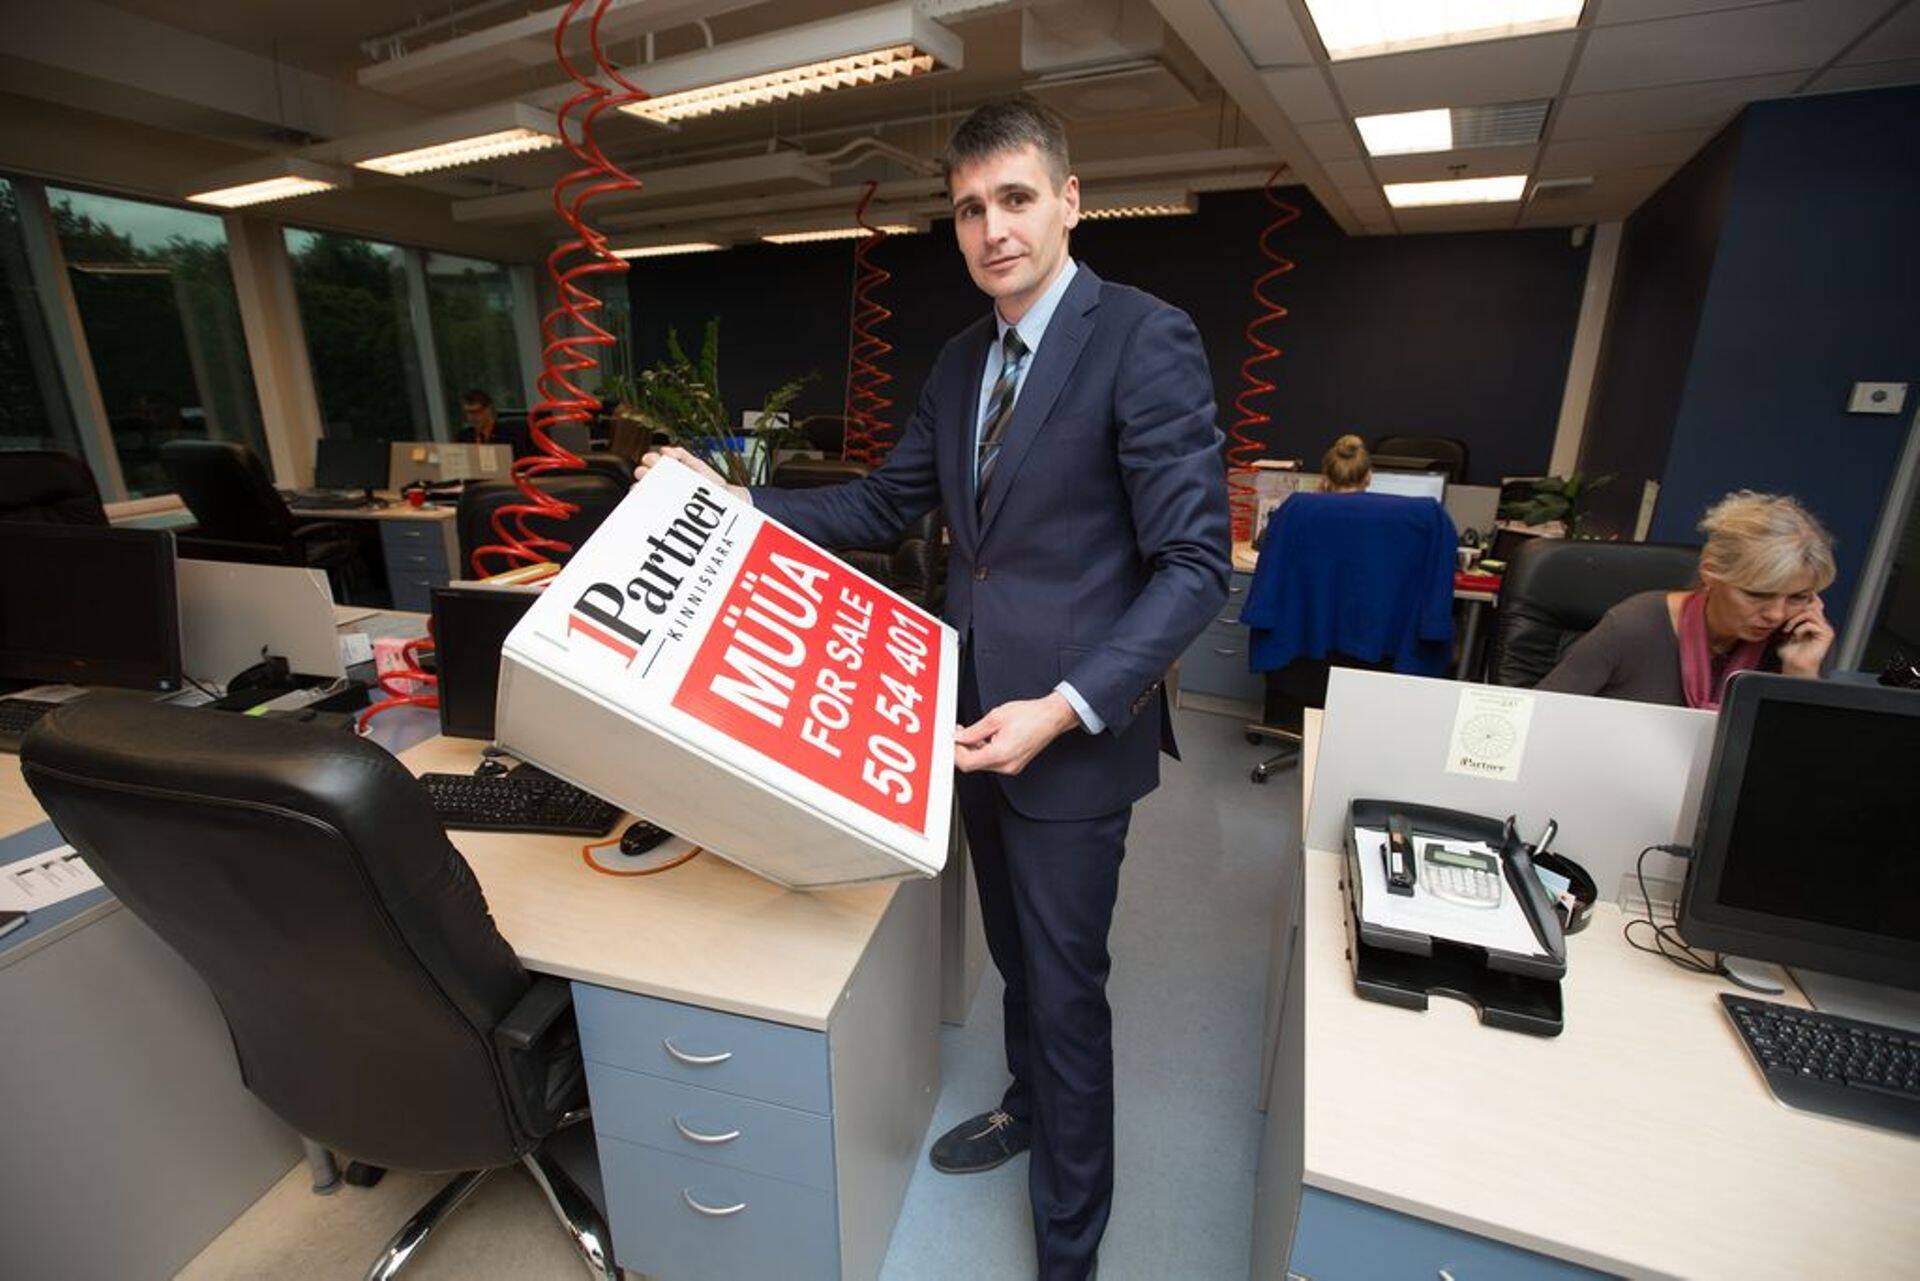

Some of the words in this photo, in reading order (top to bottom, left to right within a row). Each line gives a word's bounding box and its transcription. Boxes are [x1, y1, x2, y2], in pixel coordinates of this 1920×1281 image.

[567, 487, 728, 669] 1Partner
[668, 538, 735, 641] KINNISVARA
[709, 552, 829, 728] MÜÜA
[826, 587, 874, 670] SALE
[886, 610, 931, 676] 401
[800, 669, 857, 758] FOR
[875, 673, 923, 734] 54
[862, 736, 917, 804] 50
